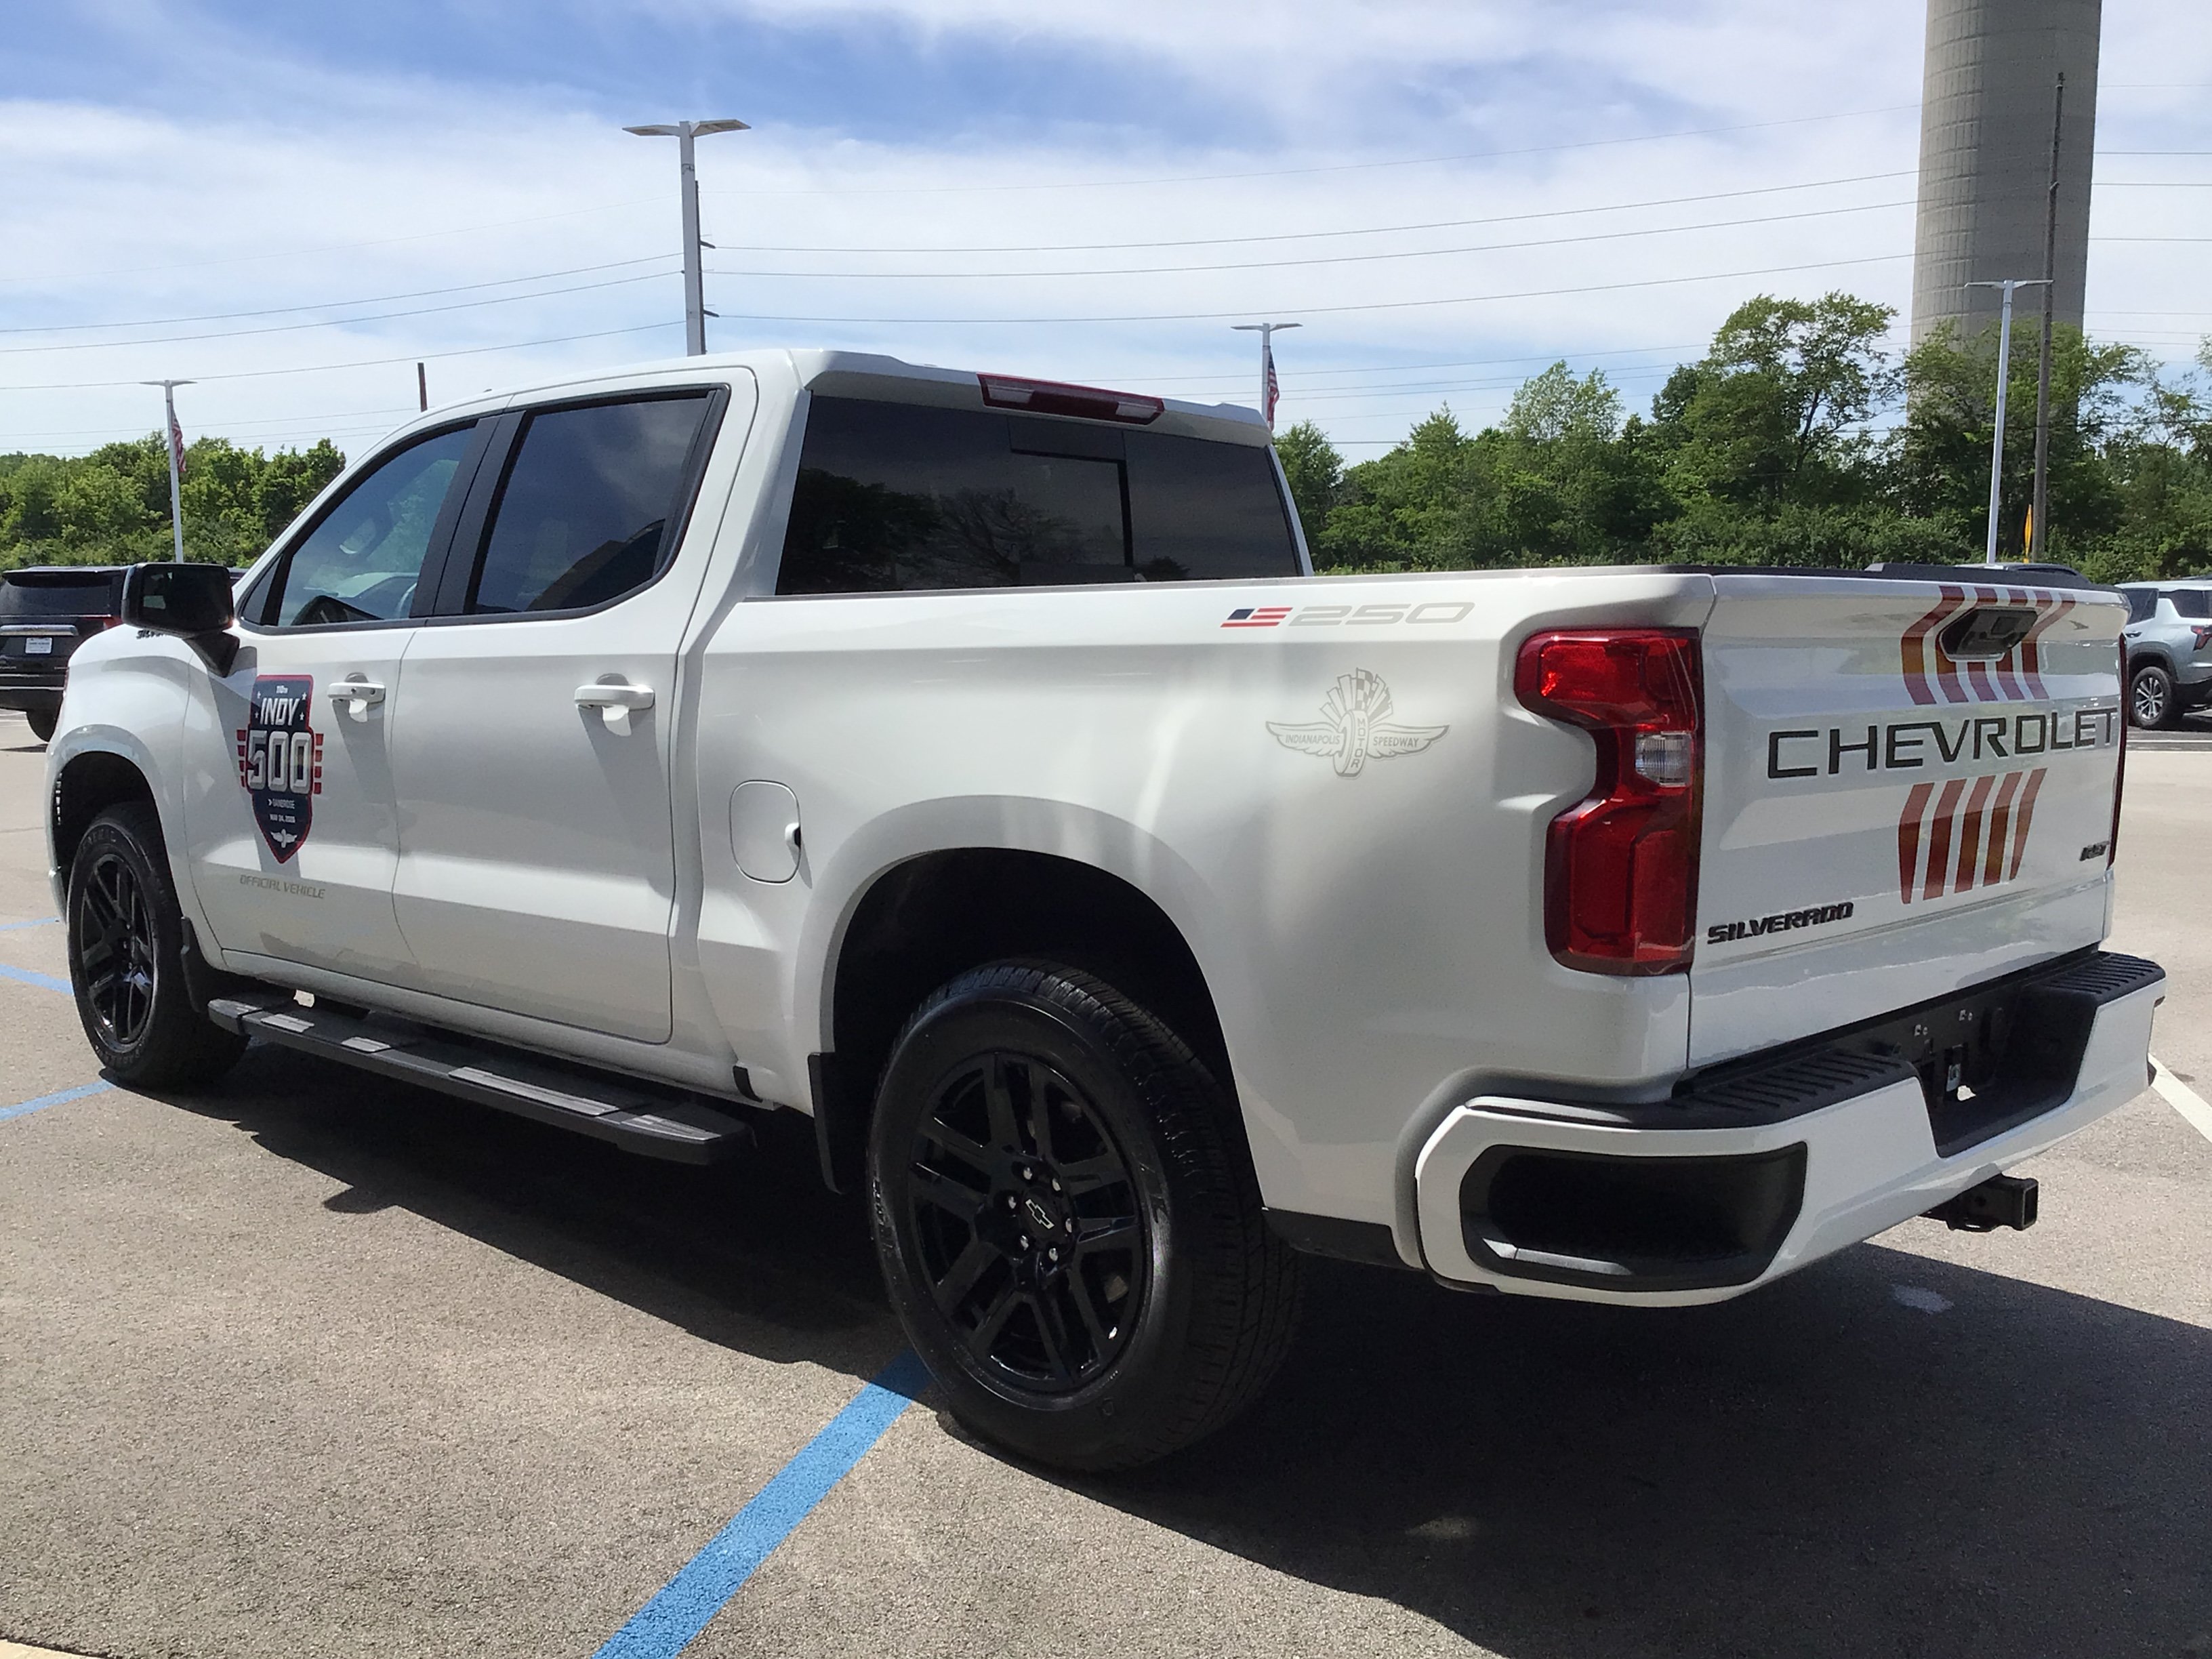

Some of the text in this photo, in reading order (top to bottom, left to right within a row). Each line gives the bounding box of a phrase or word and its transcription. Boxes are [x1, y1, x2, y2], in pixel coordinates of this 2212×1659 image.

[1288, 602, 1475, 626] 250
[260, 697, 300, 726] INDY
[1285, 734, 1341, 745] INDIANAPOLIS
[1350, 718, 1366, 769] MOTOR
[1373, 736, 1420, 748] SPEEDWAY
[1767, 707, 2118, 779] CHEVROLET
[247, 730, 312, 794] 500
[240, 874, 326, 899] OFFICIAL VEHICLE
[1707, 901, 1854, 945] SILVERADO
